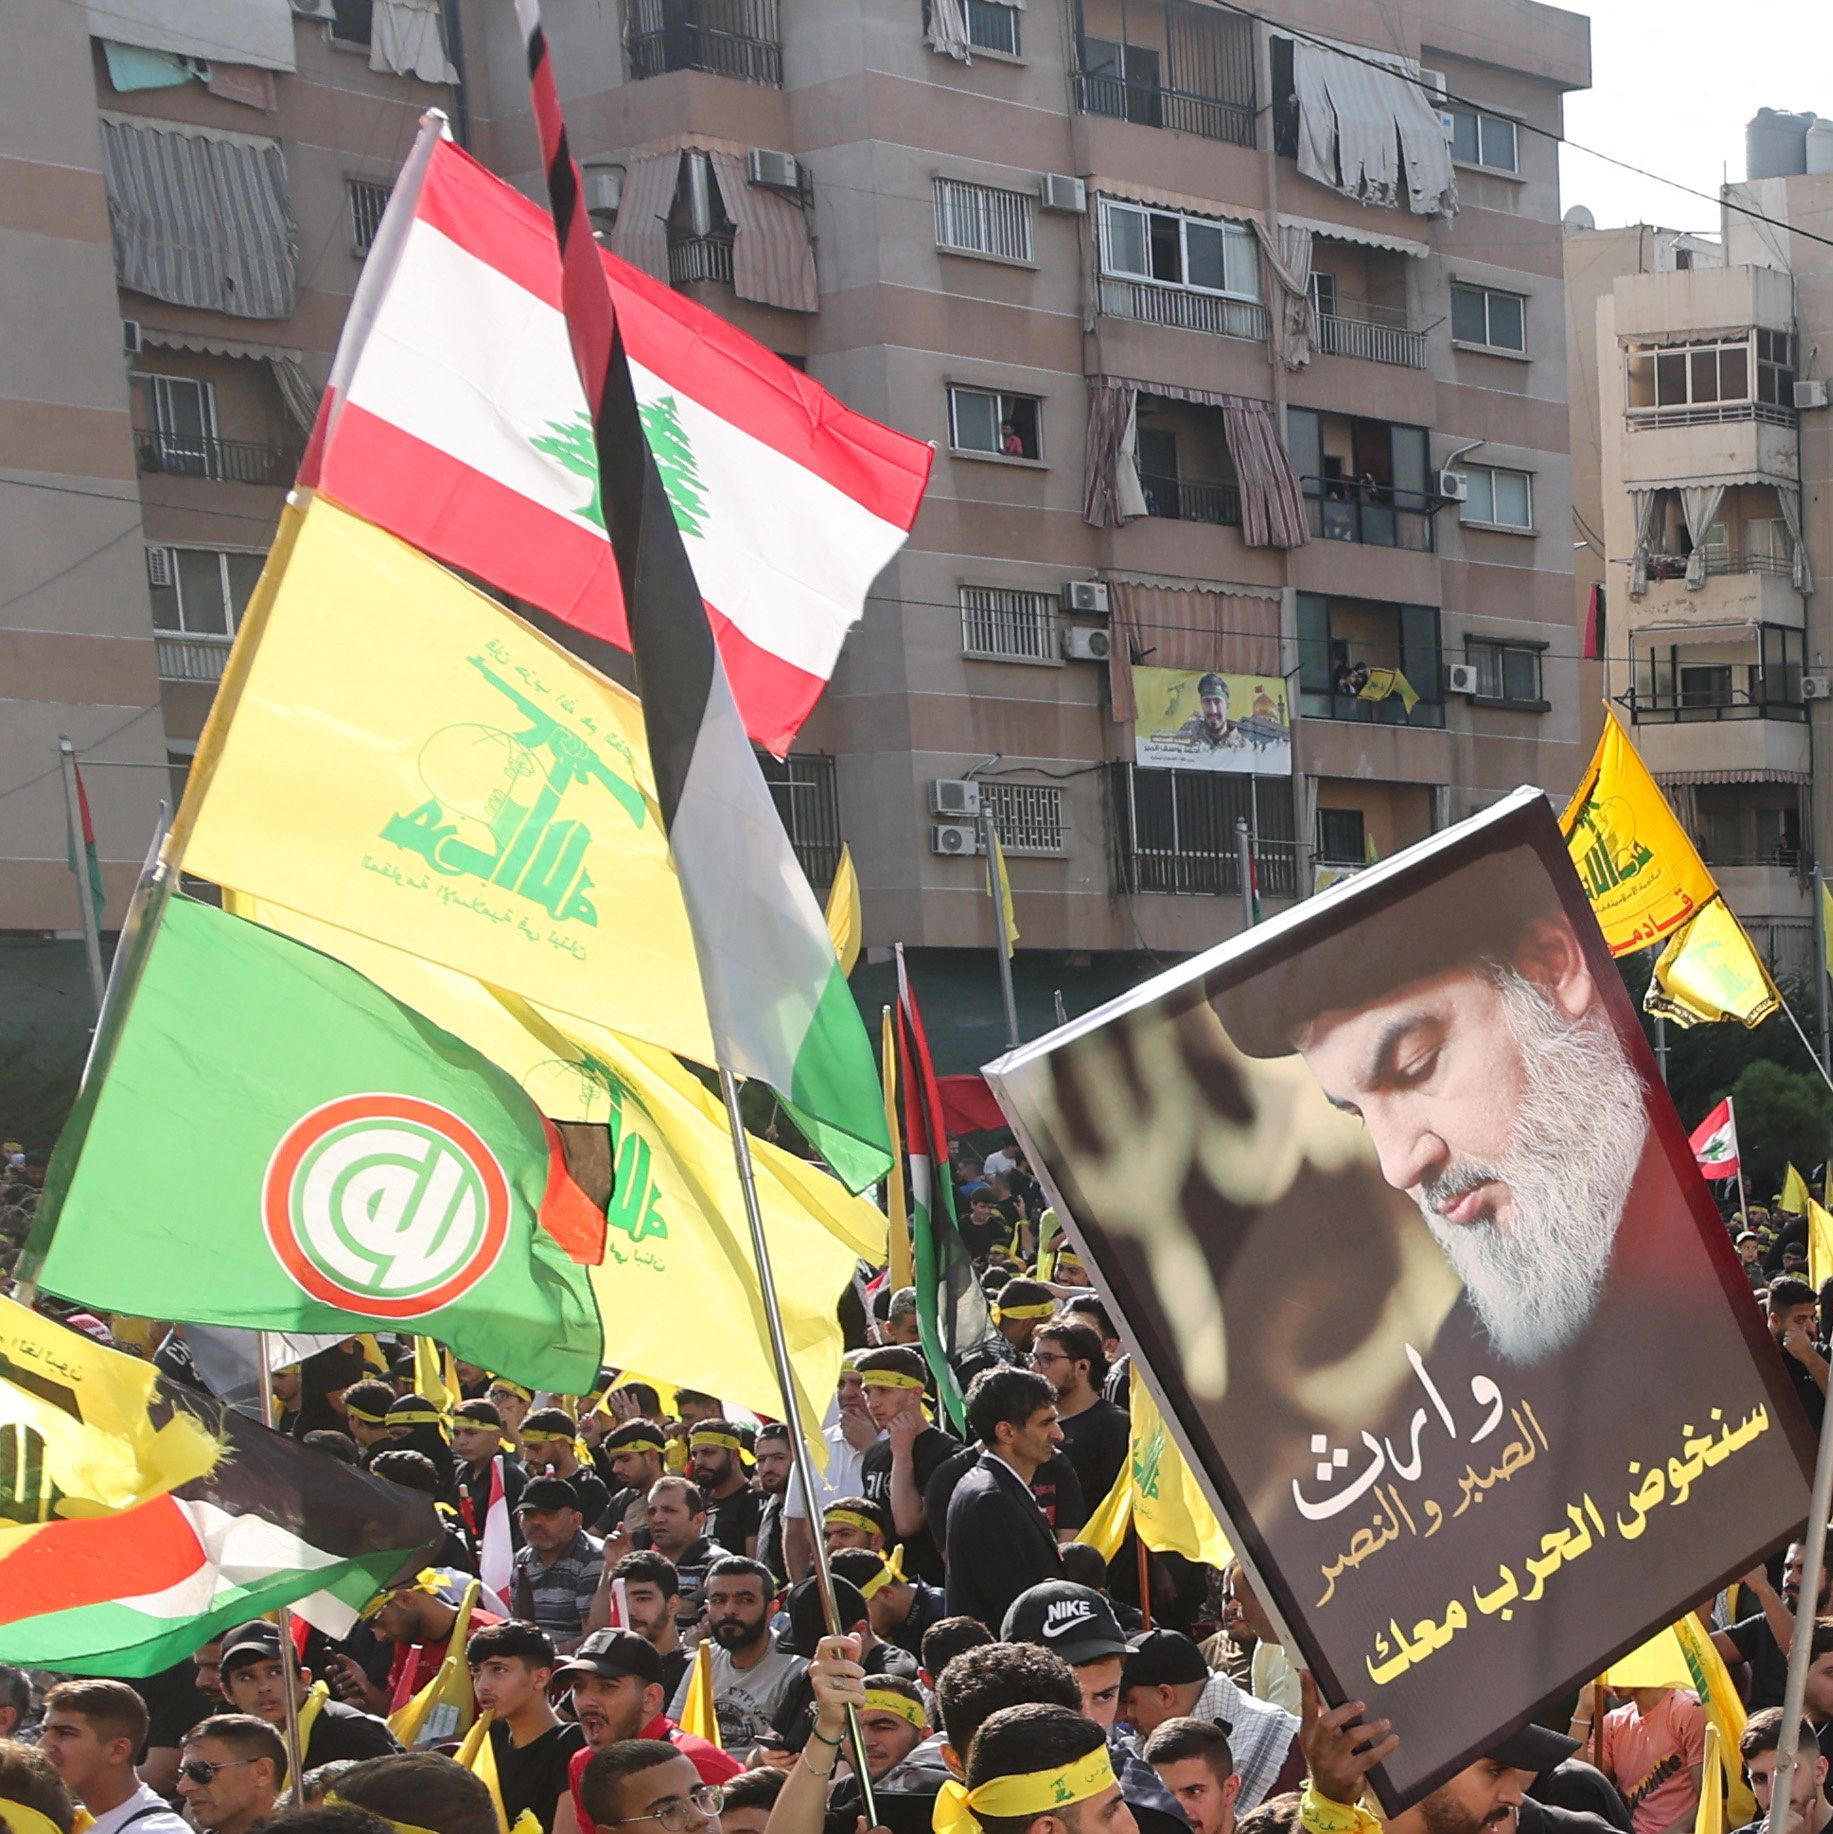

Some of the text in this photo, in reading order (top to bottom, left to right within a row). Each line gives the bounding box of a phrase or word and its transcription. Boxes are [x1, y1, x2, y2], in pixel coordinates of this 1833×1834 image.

[1607, 887, 1694, 956] قادمو
[1292, 1342, 1504, 1520] وارث
[1452, 1400, 1550, 1518] الصبر
[1366, 1402, 1770, 1685] سنخوض الحرب معك
[1047, 1599, 1092, 1622] NIKE
